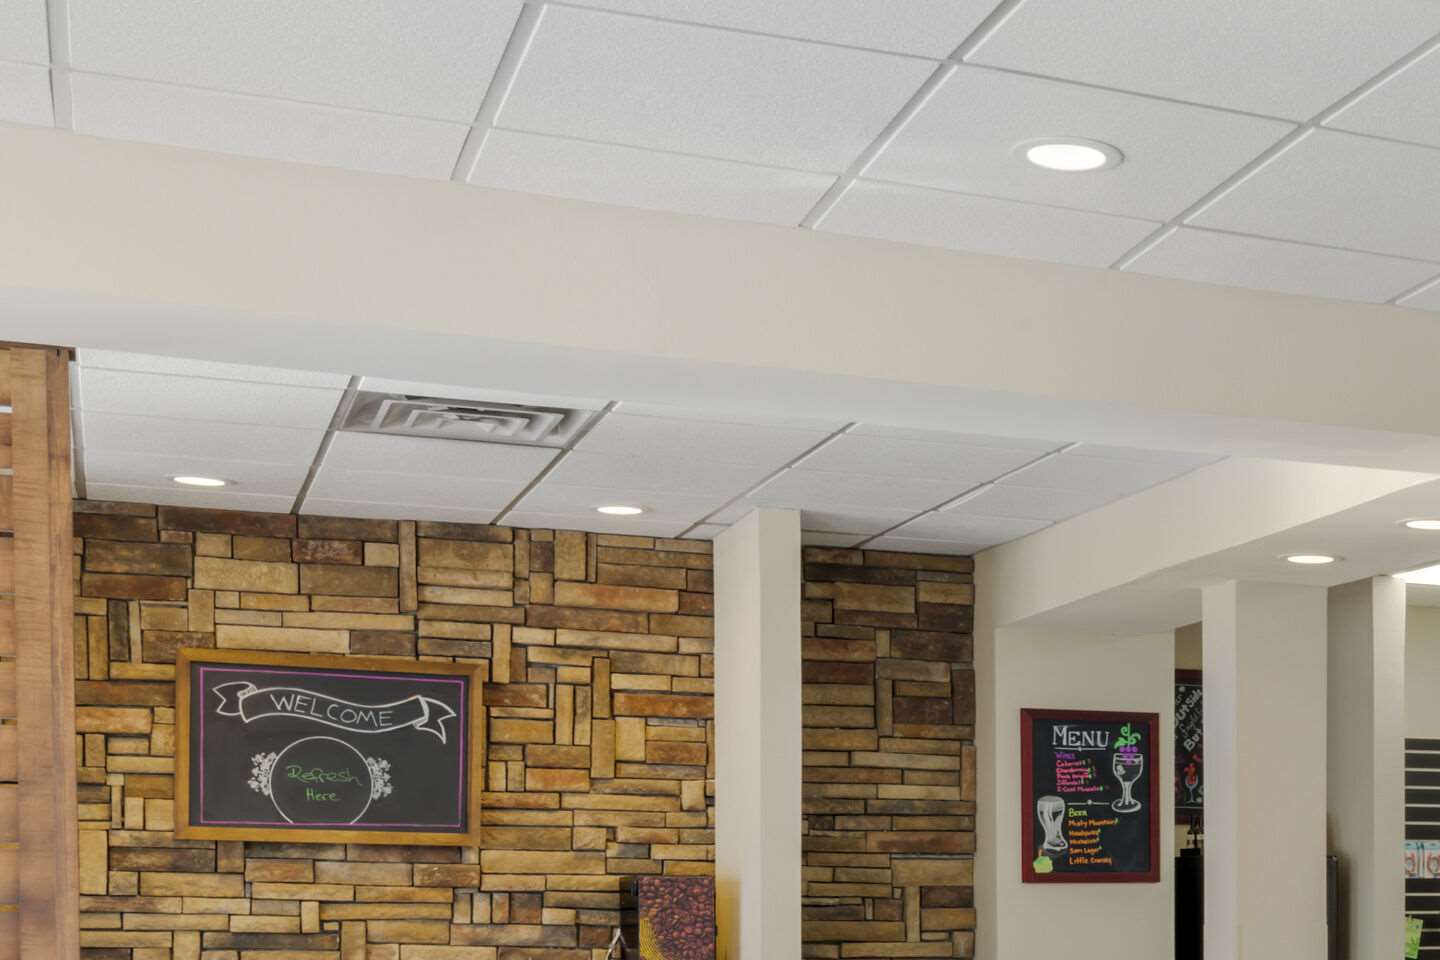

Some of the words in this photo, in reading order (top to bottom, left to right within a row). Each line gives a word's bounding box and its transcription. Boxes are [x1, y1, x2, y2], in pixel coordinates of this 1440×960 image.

[270, 693, 393, 728] WELCOME
[286, 764, 362, 786] Refresh
[305, 786, 339, 801] Here
